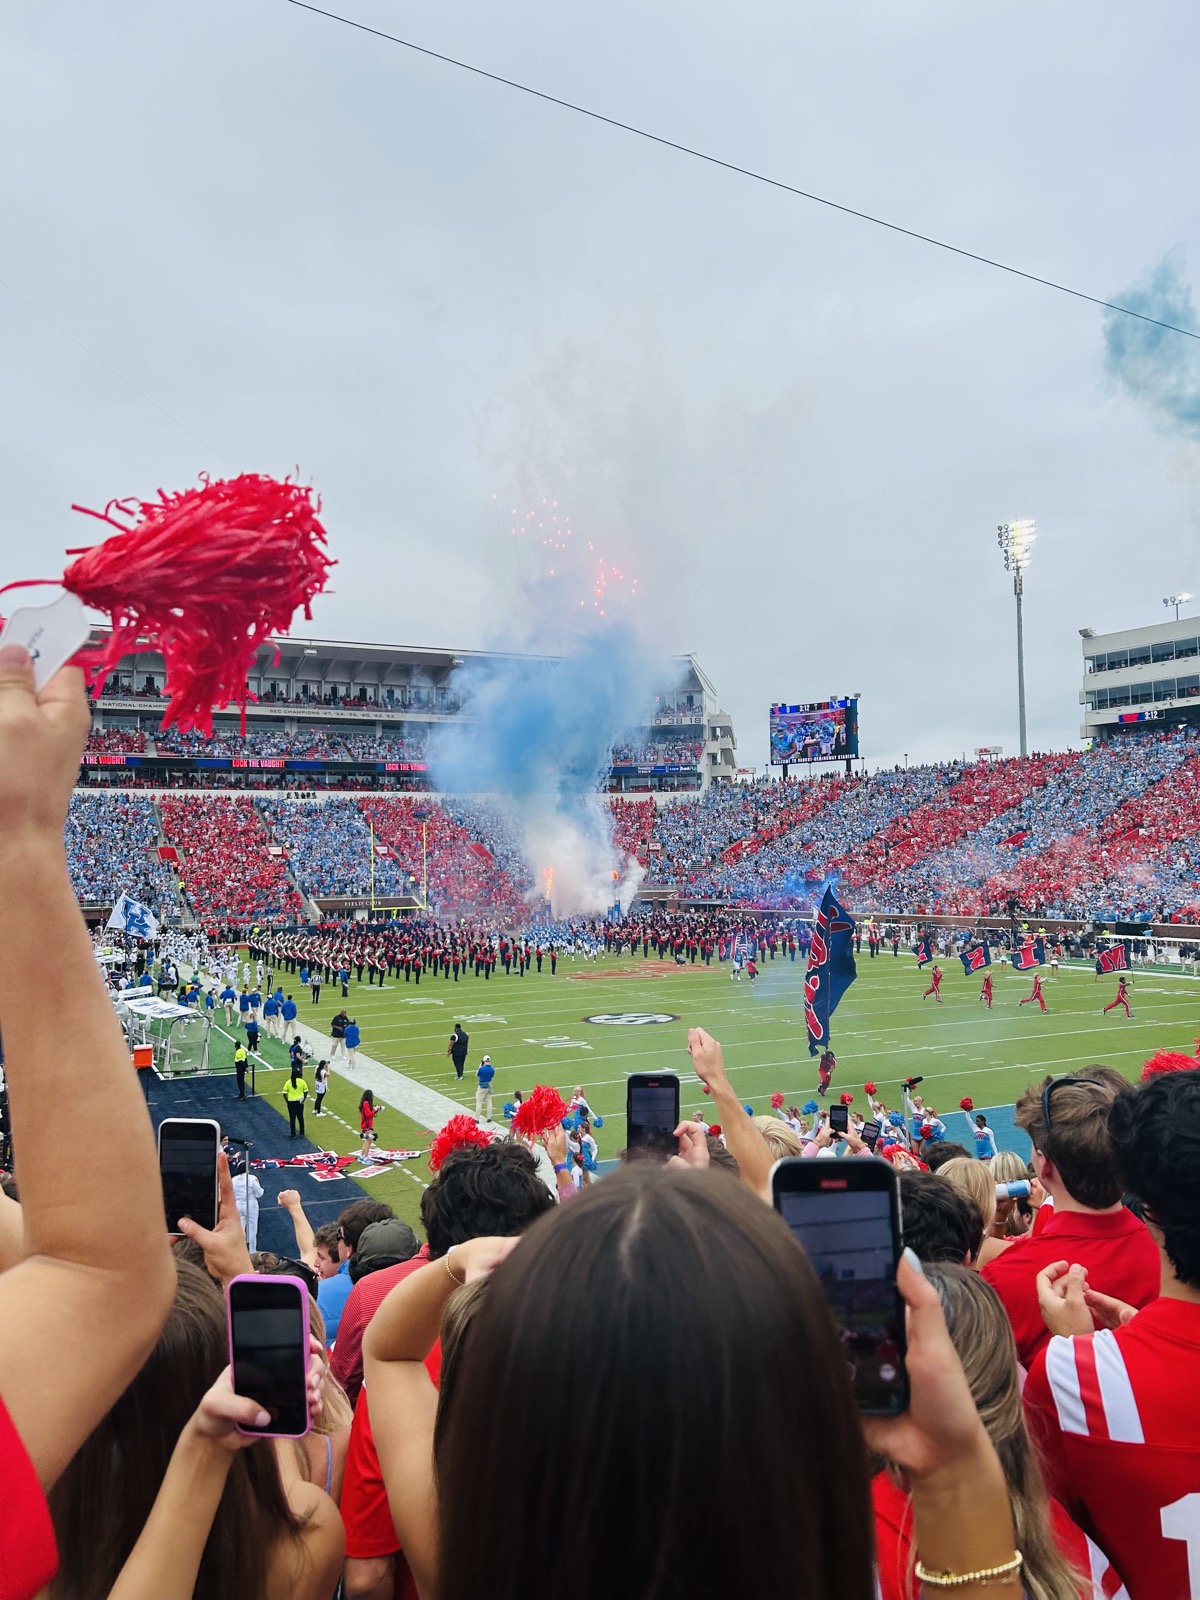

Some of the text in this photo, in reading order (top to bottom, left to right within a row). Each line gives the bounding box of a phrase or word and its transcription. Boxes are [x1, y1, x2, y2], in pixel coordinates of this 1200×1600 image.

[1144, 710, 1158, 720] 3:12
[86, 756, 98, 765] THE
[99, 756, 126, 765] VAUGHT!
[232, 759, 285, 768] LOCK THE VAUGHT!
[385, 763, 399, 771] LOCK
[400, 763, 410, 771] THE
